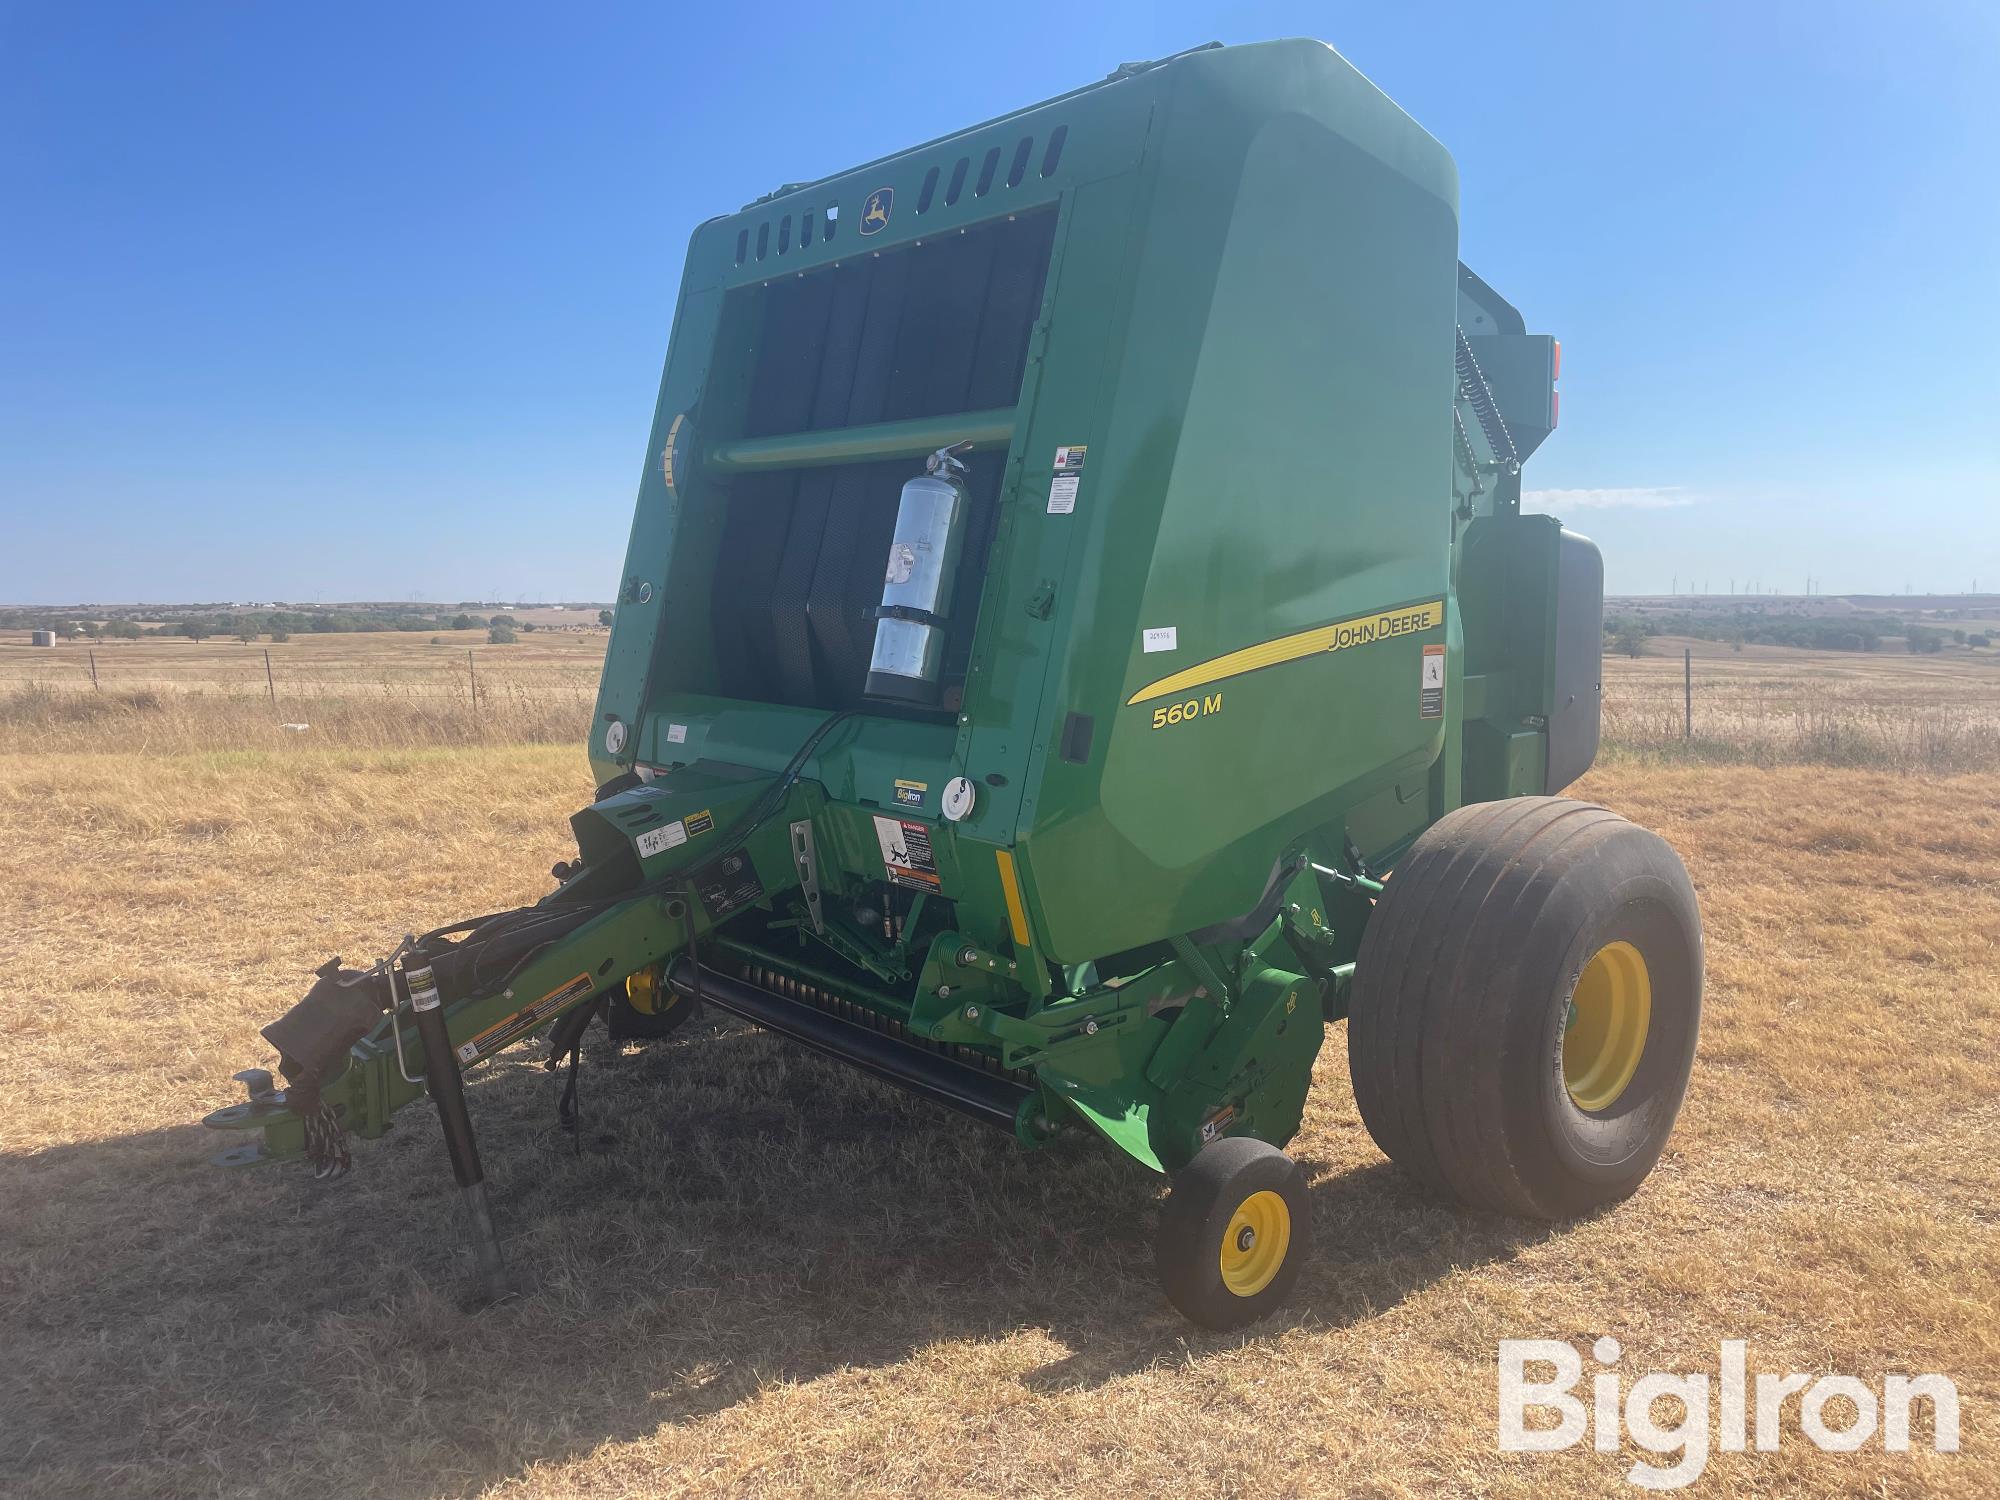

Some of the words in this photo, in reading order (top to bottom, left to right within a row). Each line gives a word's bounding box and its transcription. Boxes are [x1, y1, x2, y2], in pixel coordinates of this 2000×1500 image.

[1328, 623, 1375, 650] JOHN
[1379, 611, 1430, 637] DEERE
[1152, 704, 1199, 729] 560
[1203, 694, 1223, 716] M
[898, 788, 920, 802] BigIron
